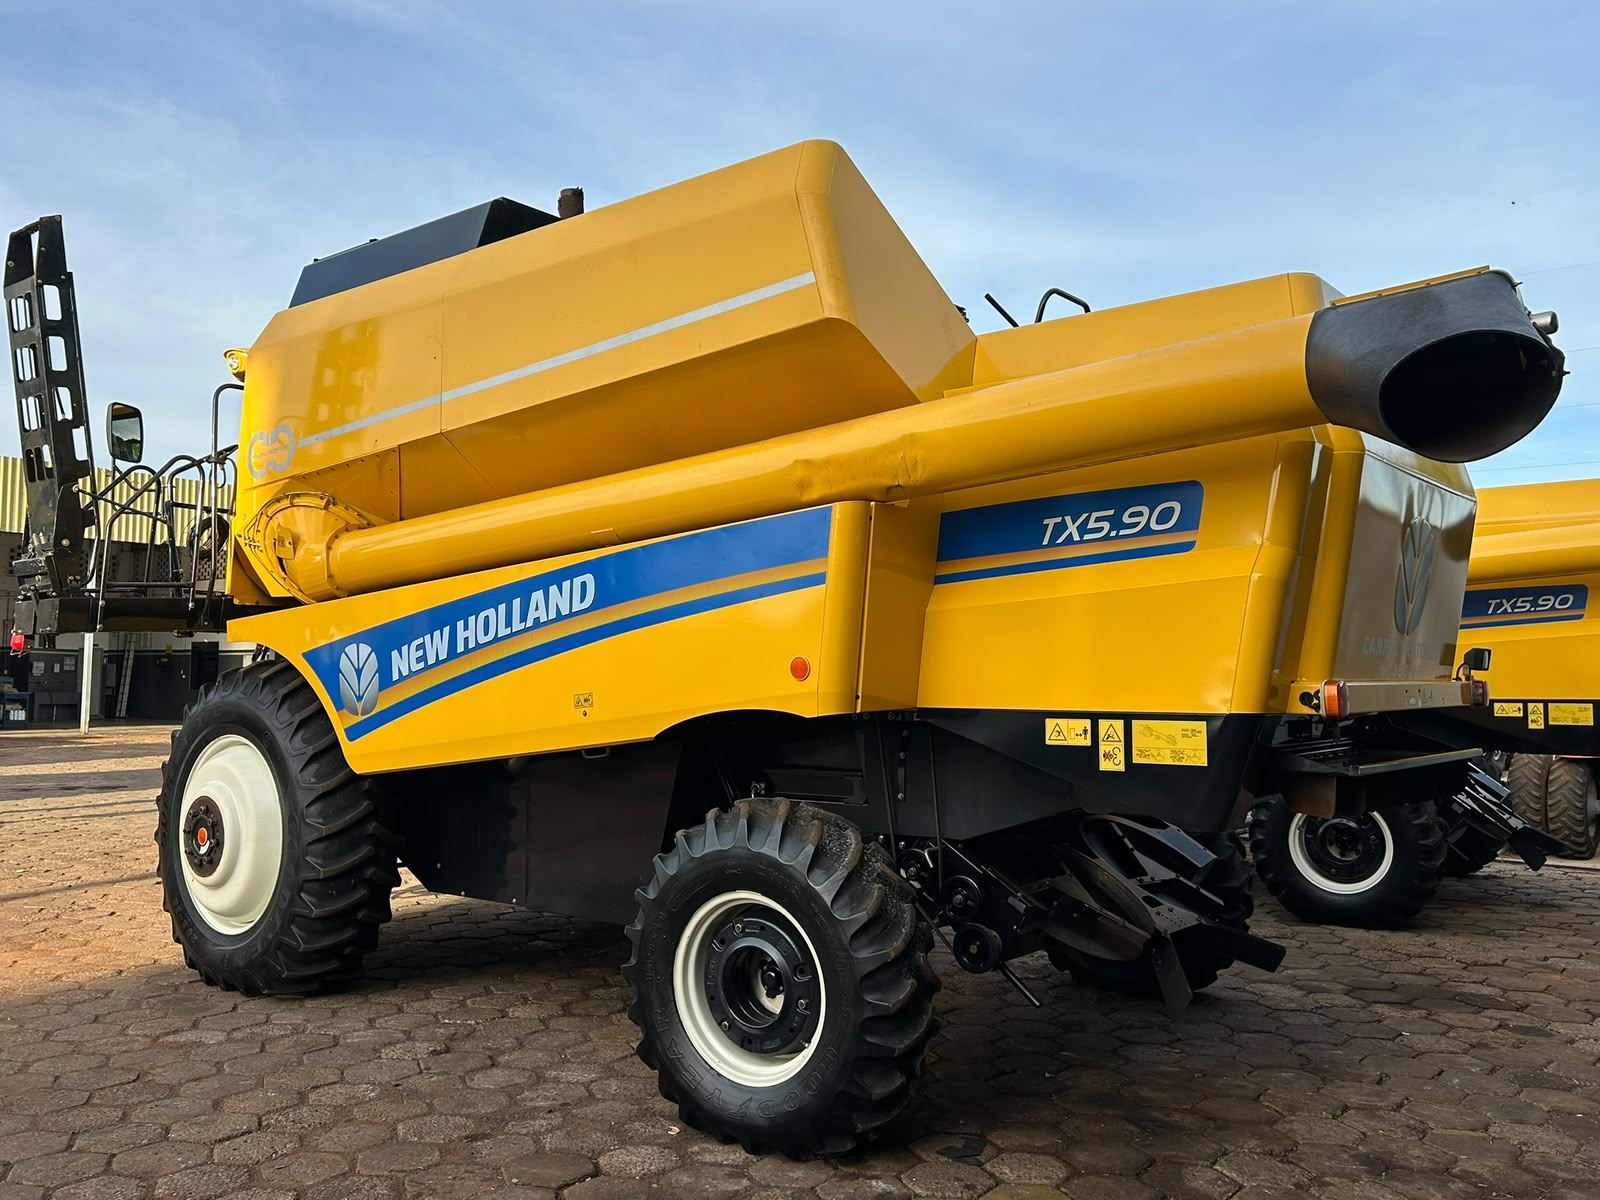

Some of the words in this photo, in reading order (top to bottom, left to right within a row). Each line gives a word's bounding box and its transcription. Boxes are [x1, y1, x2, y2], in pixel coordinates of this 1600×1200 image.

[1042, 501, 1182, 545] TX5.90
[1487, 594, 1574, 614] TX5.90
[391, 625, 450, 681] NEW
[456, 573, 596, 654] HOLLAND
